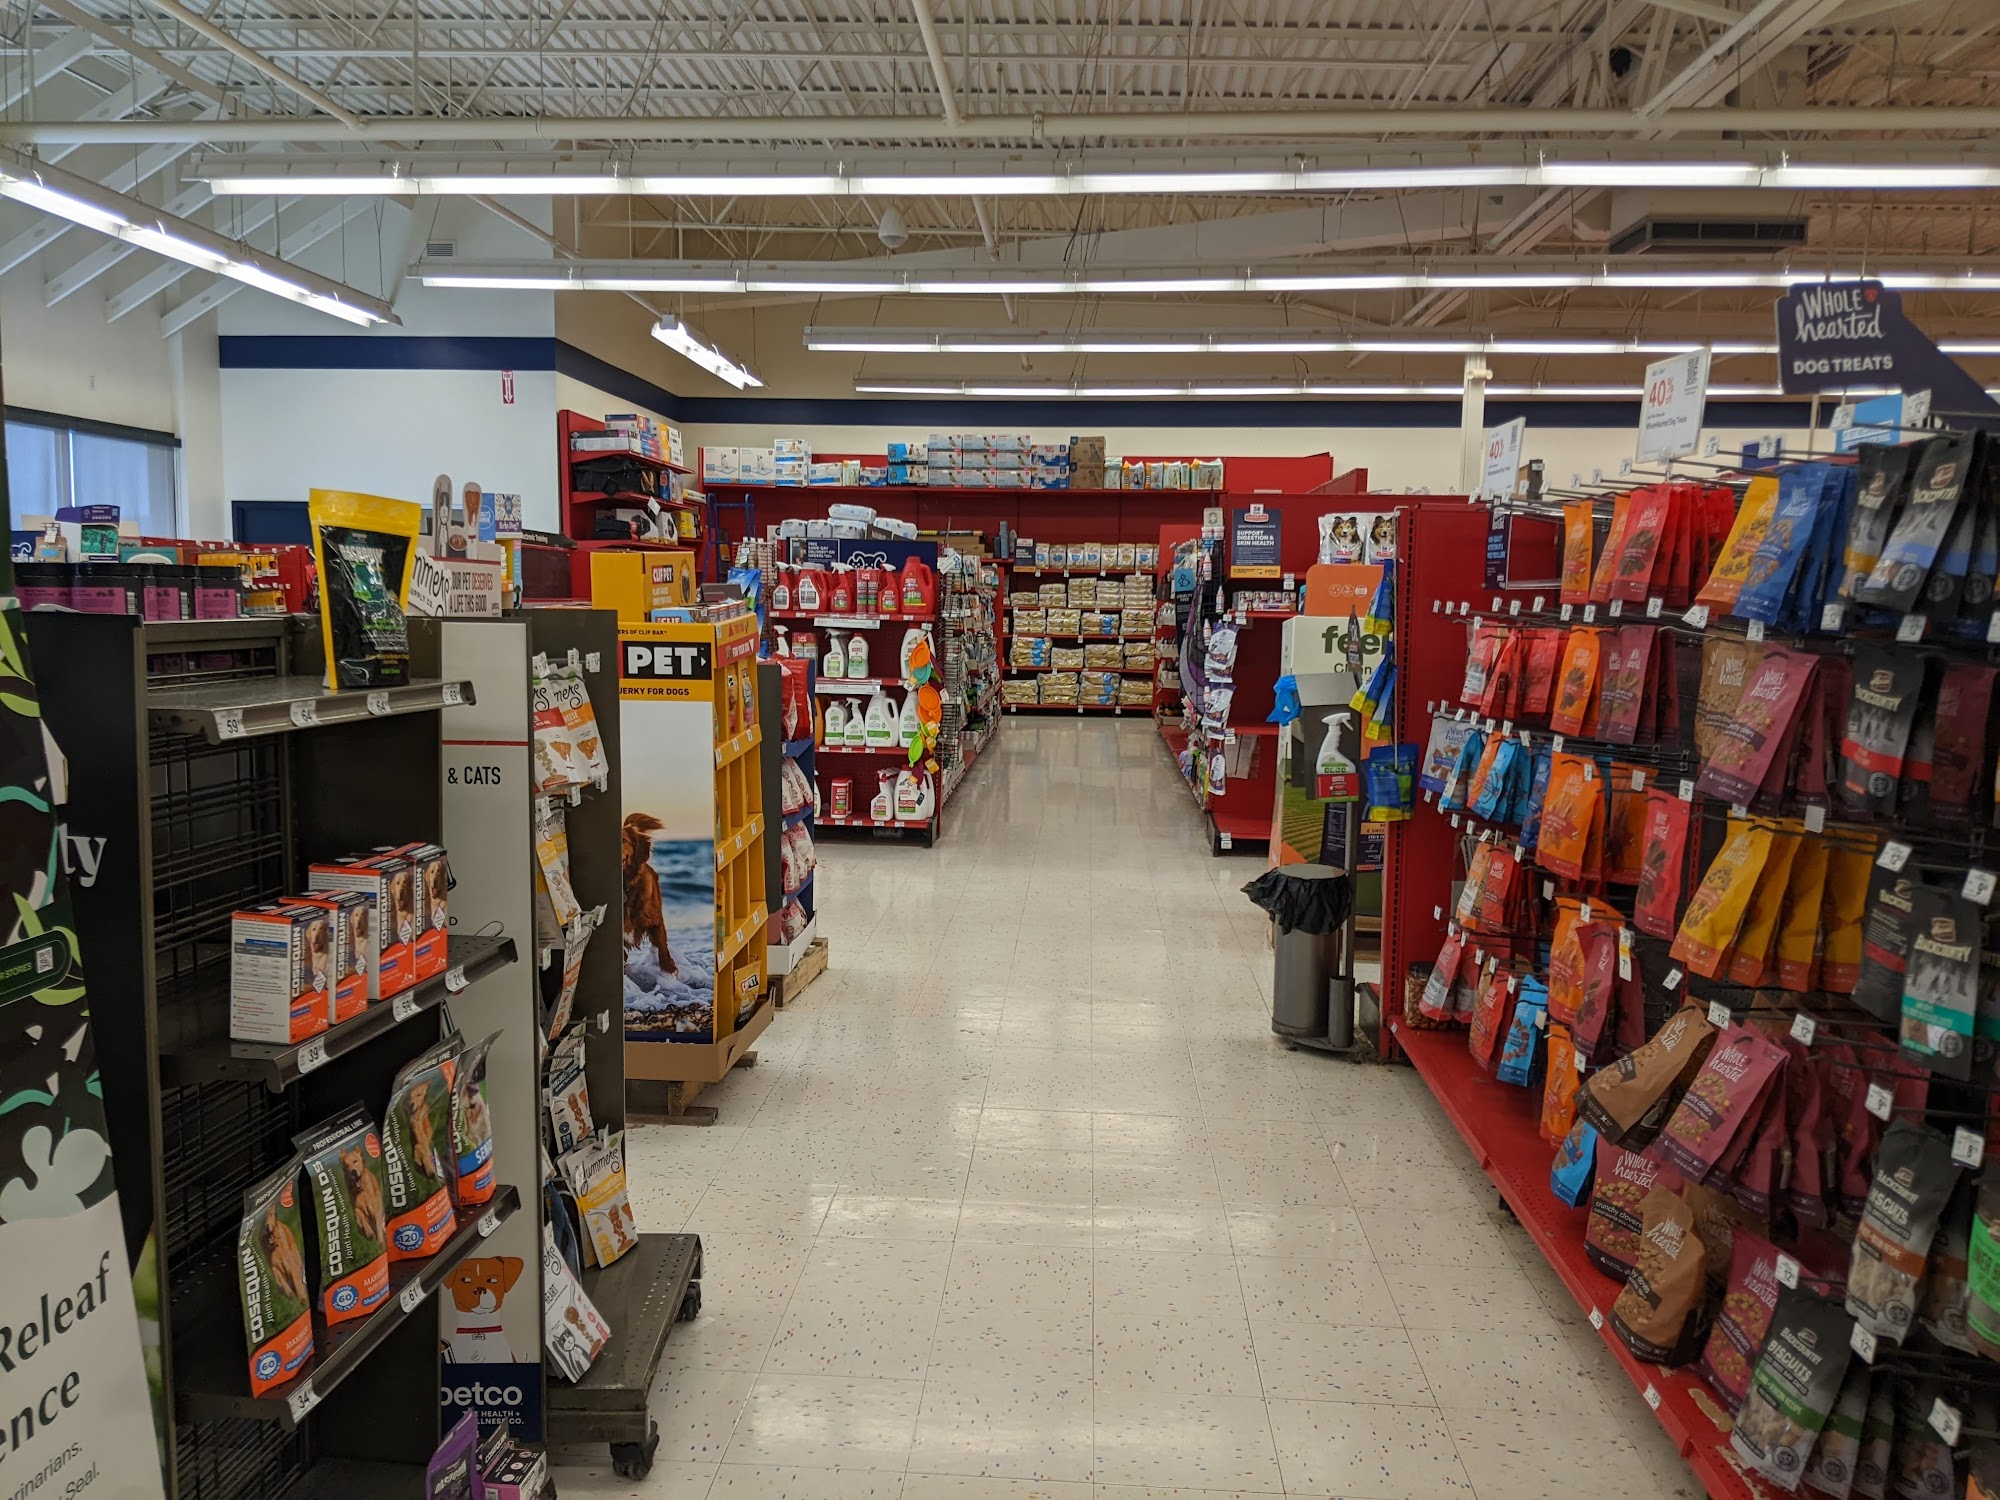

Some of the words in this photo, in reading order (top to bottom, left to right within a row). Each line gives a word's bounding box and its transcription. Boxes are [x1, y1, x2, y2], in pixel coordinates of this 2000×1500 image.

[1802, 286, 1863, 320] WHOLE
[1795, 303, 1886, 343] hearted
[1793, 357, 1830, 375] DOG
[1832, 355, 1893, 373] TREATS
[451, 571, 461, 590] OUR
[472, 572, 493, 592] DESERVES
[653, 567, 663, 583] CLIF
[663, 567, 673, 582] PET
[454, 595, 463, 613] LIFE
[464, 595, 474, 612] THIS
[475, 595, 487, 612] GOOD
[627, 646, 698, 675] PET
[1334, 663, 1372, 675] Cln
[619, 687, 645, 695] JERKY
[666, 688, 690, 696] DOGS
[447, 767, 459, 784] &
[464, 766, 501, 785] CATS
[338, 912, 346, 980] COSEQUIN
[292, 926, 301, 998] COSEQUIN
[1709, 1049, 1749, 1083] hearted
[1721, 1045, 1748, 1067] WHOLE
[312, 1126, 353, 1151] PROFESSIONAL
[352, 1119, 363, 1130] LINE
[313, 1160, 330, 1187] DS
[1612, 1156, 1658, 1191] hearted
[1624, 1150, 1655, 1173] WHOLE
[328, 1168, 347, 1213] Supplement
[1595, 1201, 1619, 1217] crunchy
[1619, 1211, 1643, 1228] clovers
[322, 1188, 344, 1277] COSEQUIN
[342, 1214, 351, 1244] Health
[398, 1224, 417, 1233] Tasty
[398, 1232, 418, 1243] 120
[1645, 1221, 1685, 1261] hearted
[346, 1245, 354, 1260] Joint
[241, 1249, 265, 1344] COSEQUIN
[262, 1274, 272, 1305] Health
[338, 1293, 352, 1303] 60
[266, 1306, 275, 1323] Joint
[332, 1302, 344, 1311] Soft
[1780, 1326, 1824, 1366] BACKCOUNTRY
[262, 1361, 275, 1370] 60
[1767, 1339, 1812, 1383] BISCUITS
[297, 1389, 310, 1408] 34
[440, 1381, 523, 1406] petco
[0, 1371, 80, 1464] nce
[8, 1442, 82, 1500] rinarians.
[65, 1461, 100, 1500] Seal.
